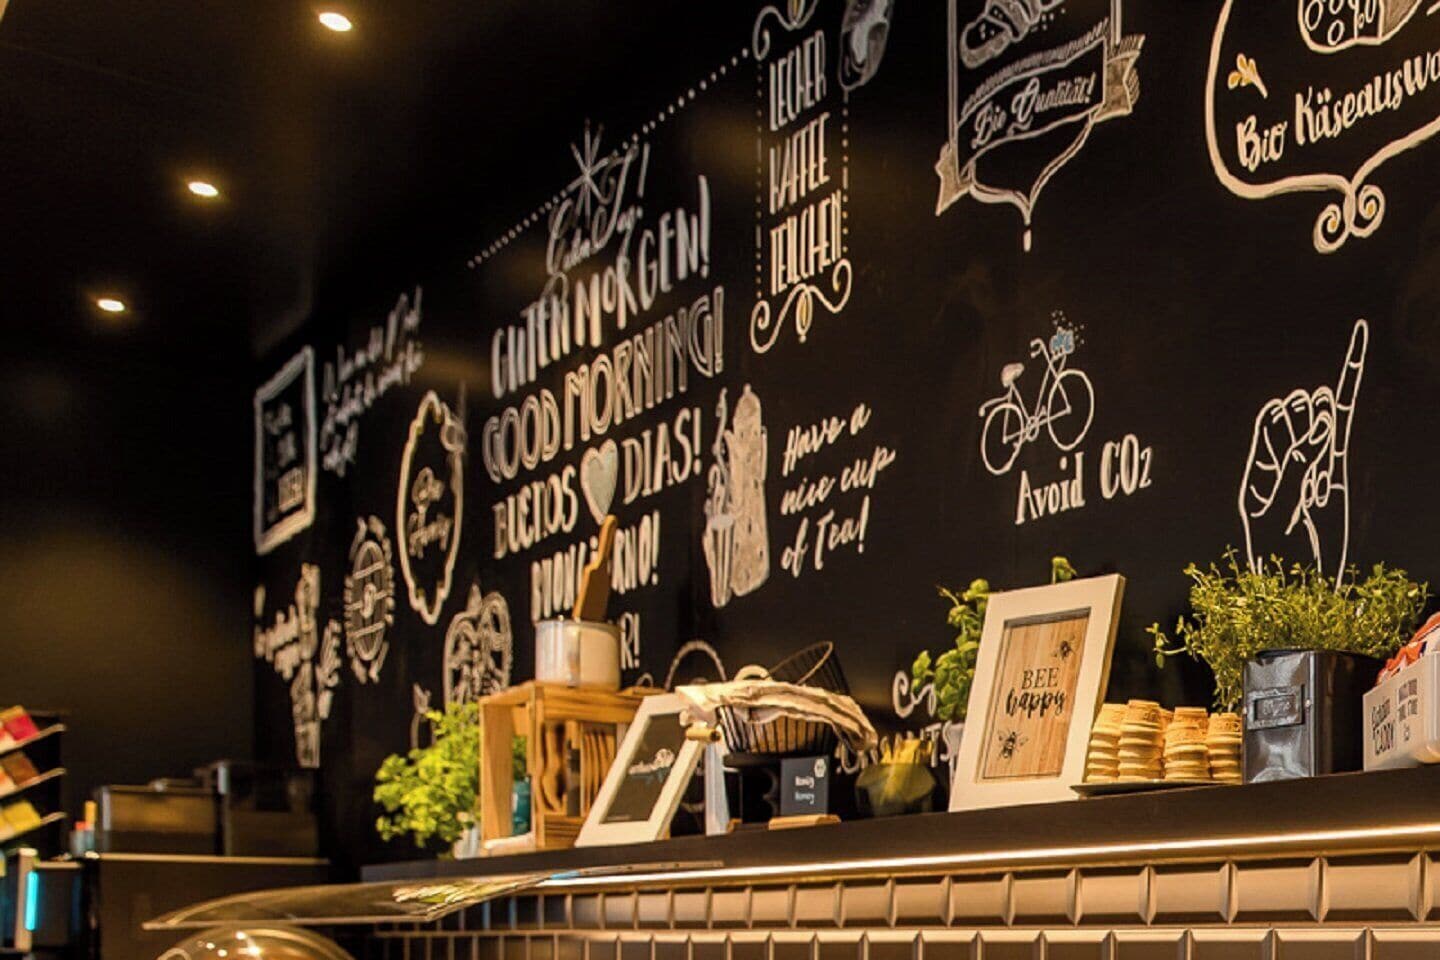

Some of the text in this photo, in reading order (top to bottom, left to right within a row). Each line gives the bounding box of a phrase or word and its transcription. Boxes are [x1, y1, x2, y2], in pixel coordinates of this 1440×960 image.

[969, 100, 1008, 150] Bio
[1237, 115, 1288, 172] Bio
[769, 112, 831, 216] KAFFEE
[573, 174, 711, 348] MORGEN!
[482, 388, 562, 485] GOOD
[563, 284, 725, 452] MORNING!
[621, 407, 703, 506] DIAS!
[782, 402, 873, 477] Have a
[780, 445, 897, 517] nice cup
[1015, 456, 1085, 525] Avoid
[780, 496, 871, 578] of Tea!
[1005, 688, 1067, 720] happy
[1021, 666, 1060, 690] BEE
